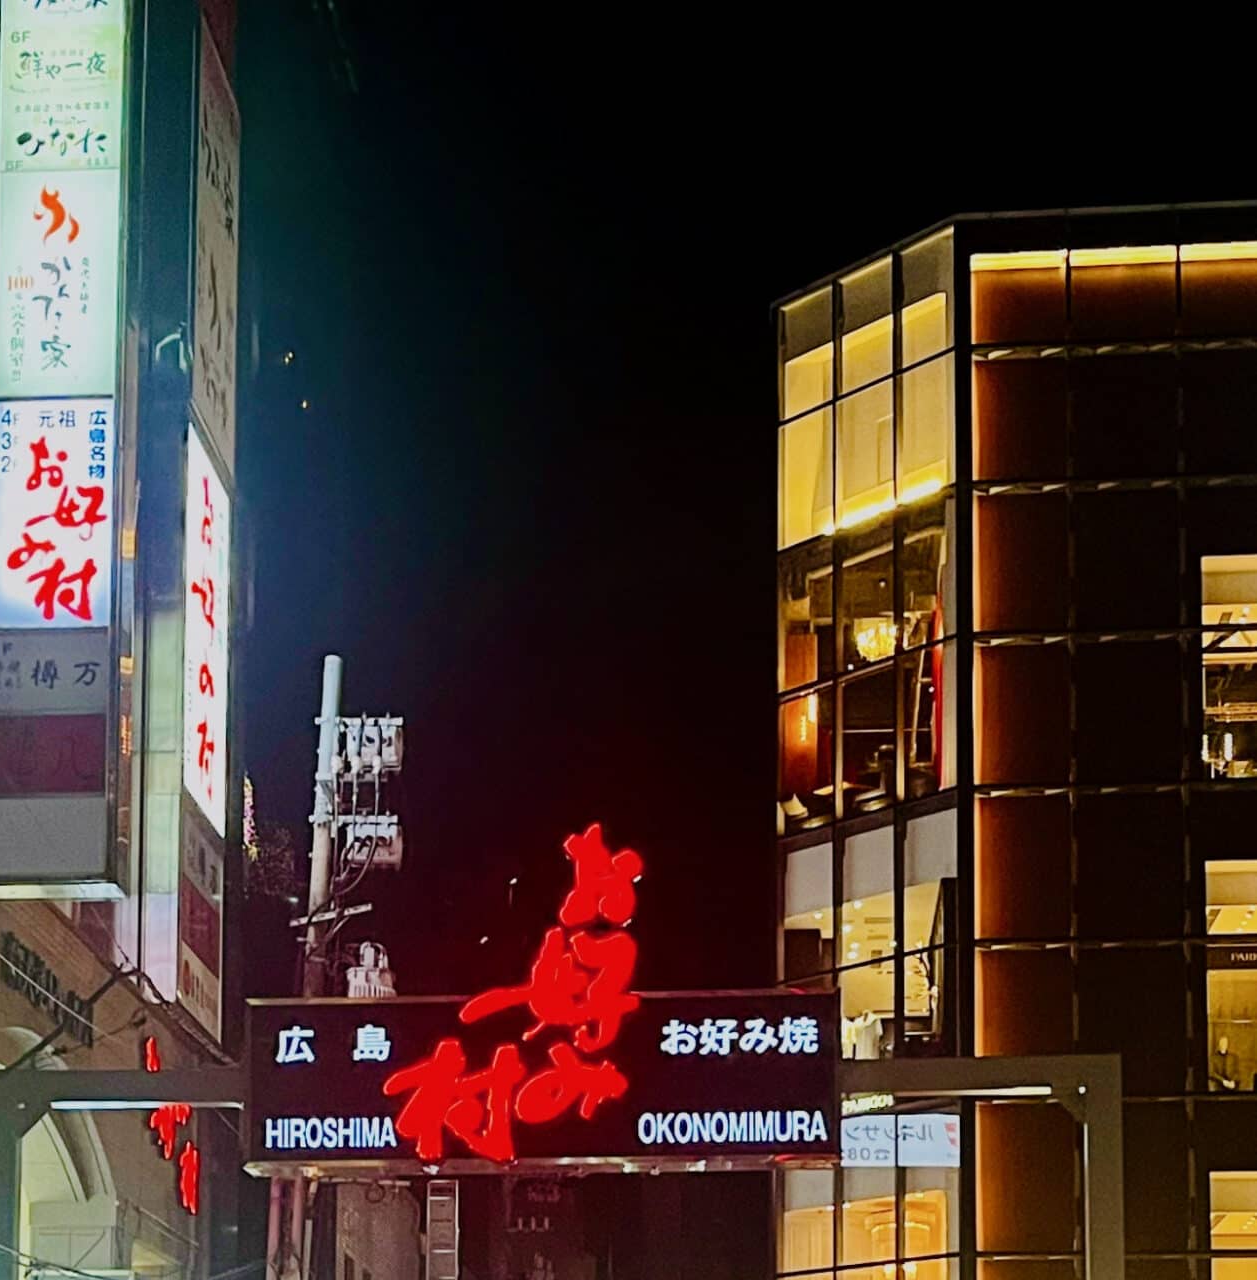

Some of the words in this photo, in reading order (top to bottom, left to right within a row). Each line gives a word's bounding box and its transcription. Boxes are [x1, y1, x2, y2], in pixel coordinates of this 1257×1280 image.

[38, 410, 76, 428] 元祖
[88, 409, 108, 480] 広島名物
[6, 436, 108, 621] お好み村
[275, 1025, 392, 1064] 広島
[660, 1017, 820, 1057] お好み焼
[265, 1116, 397, 1149] HIROSHIMA
[638, 1110, 828, 1145] OKONOMIMURA
